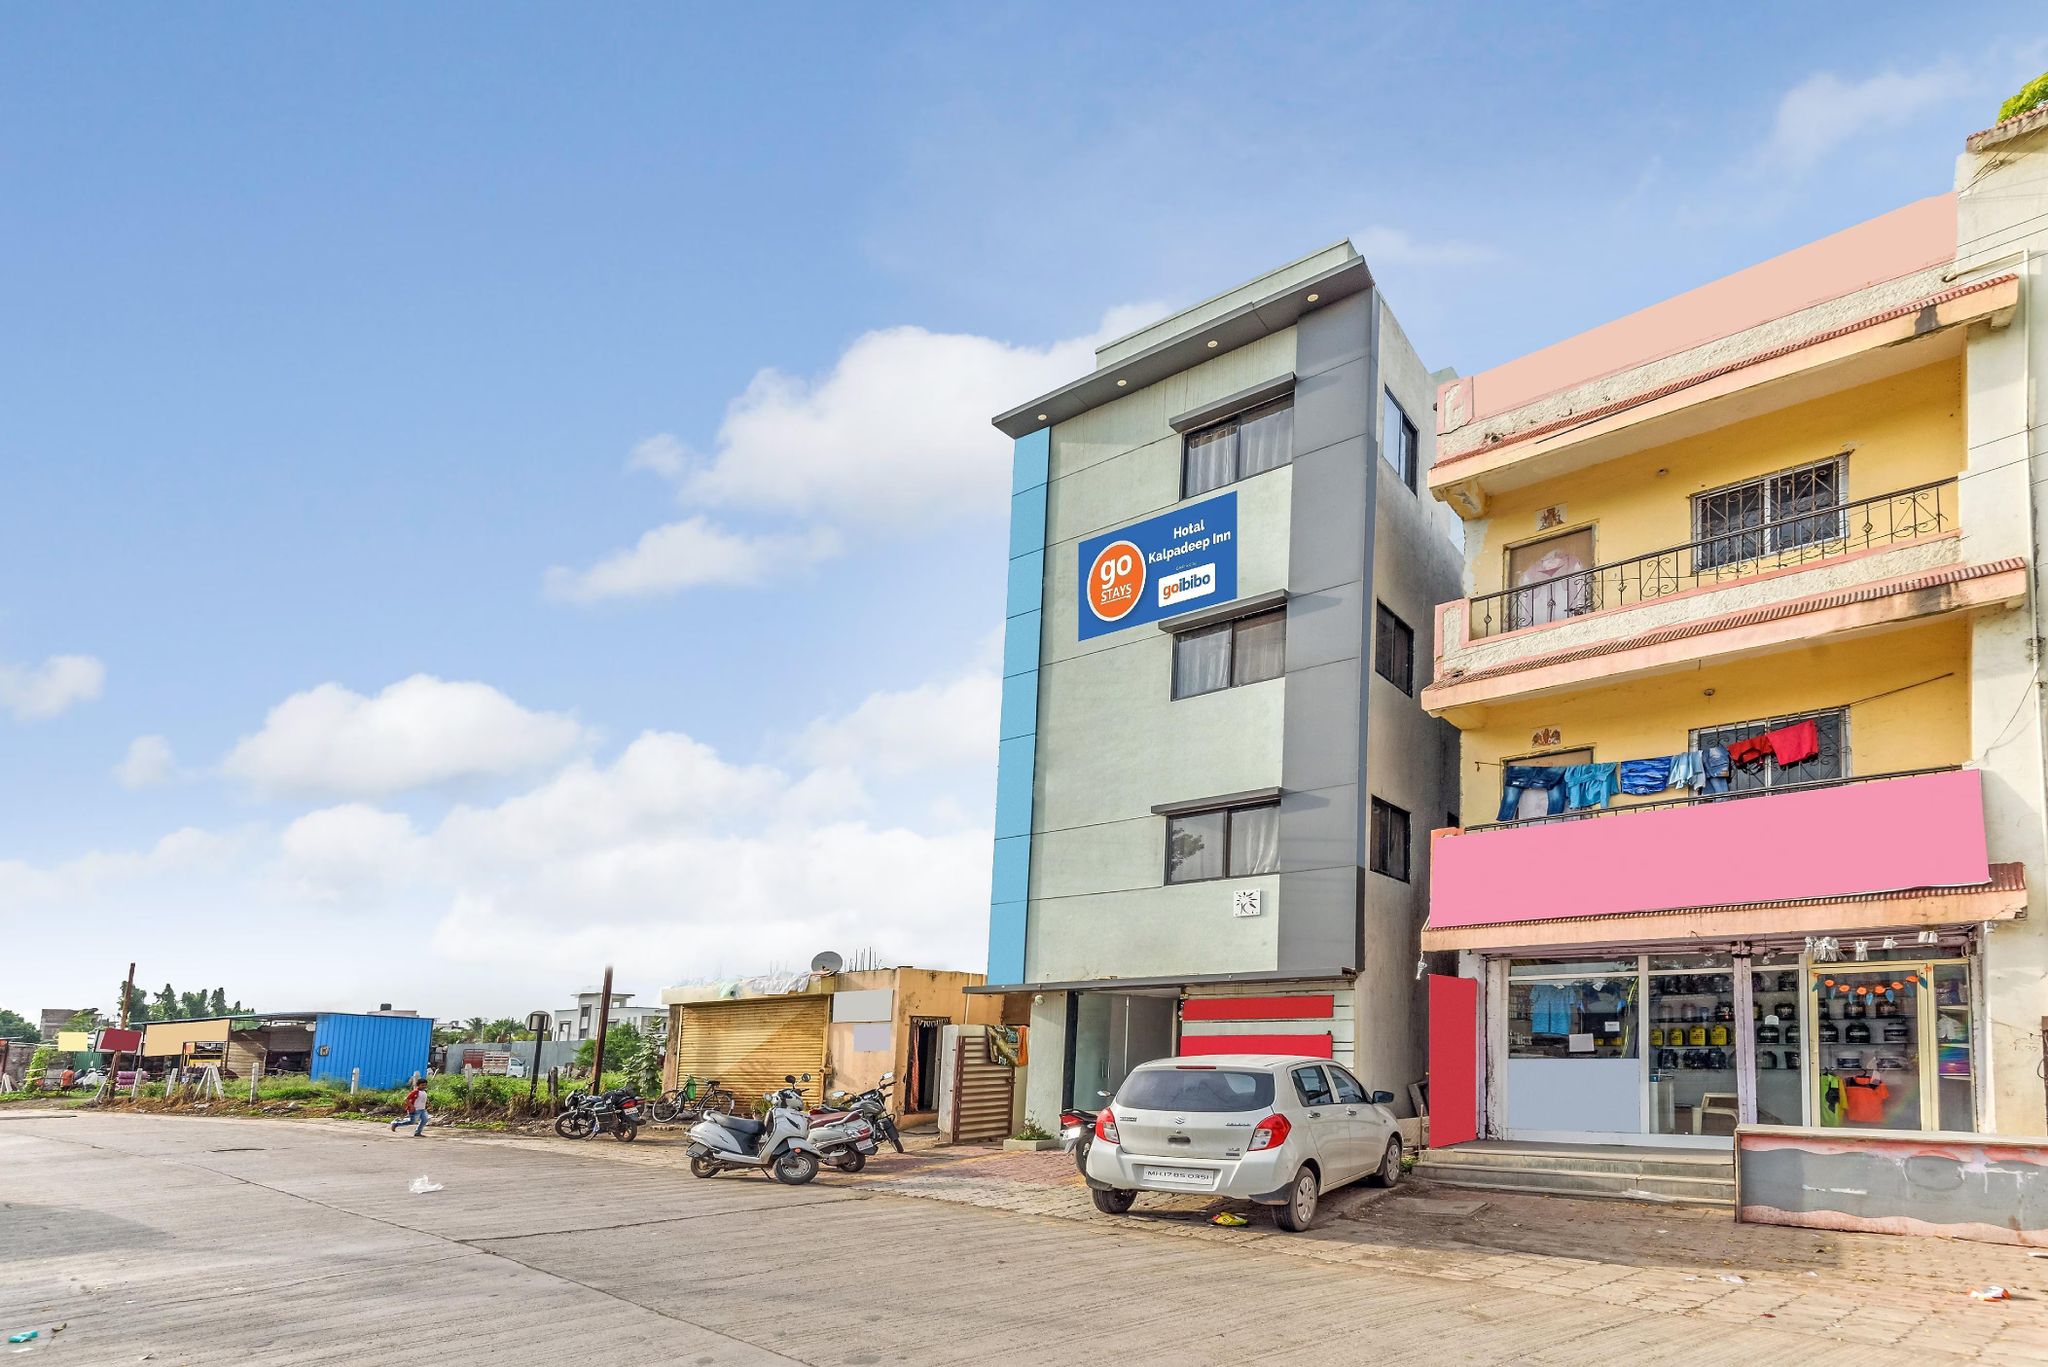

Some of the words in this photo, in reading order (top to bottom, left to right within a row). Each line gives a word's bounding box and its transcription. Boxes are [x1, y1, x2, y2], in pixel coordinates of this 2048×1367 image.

[1173, 519, 1206, 539] Hotal
[1148, 537, 1210, 564] Kalpadeep
[1212, 531, 1231, 545] Inn
[1100, 554, 1132, 590] go
[1101, 583, 1132, 602] STAYS
[1163, 574, 1211, 600] goibibo
